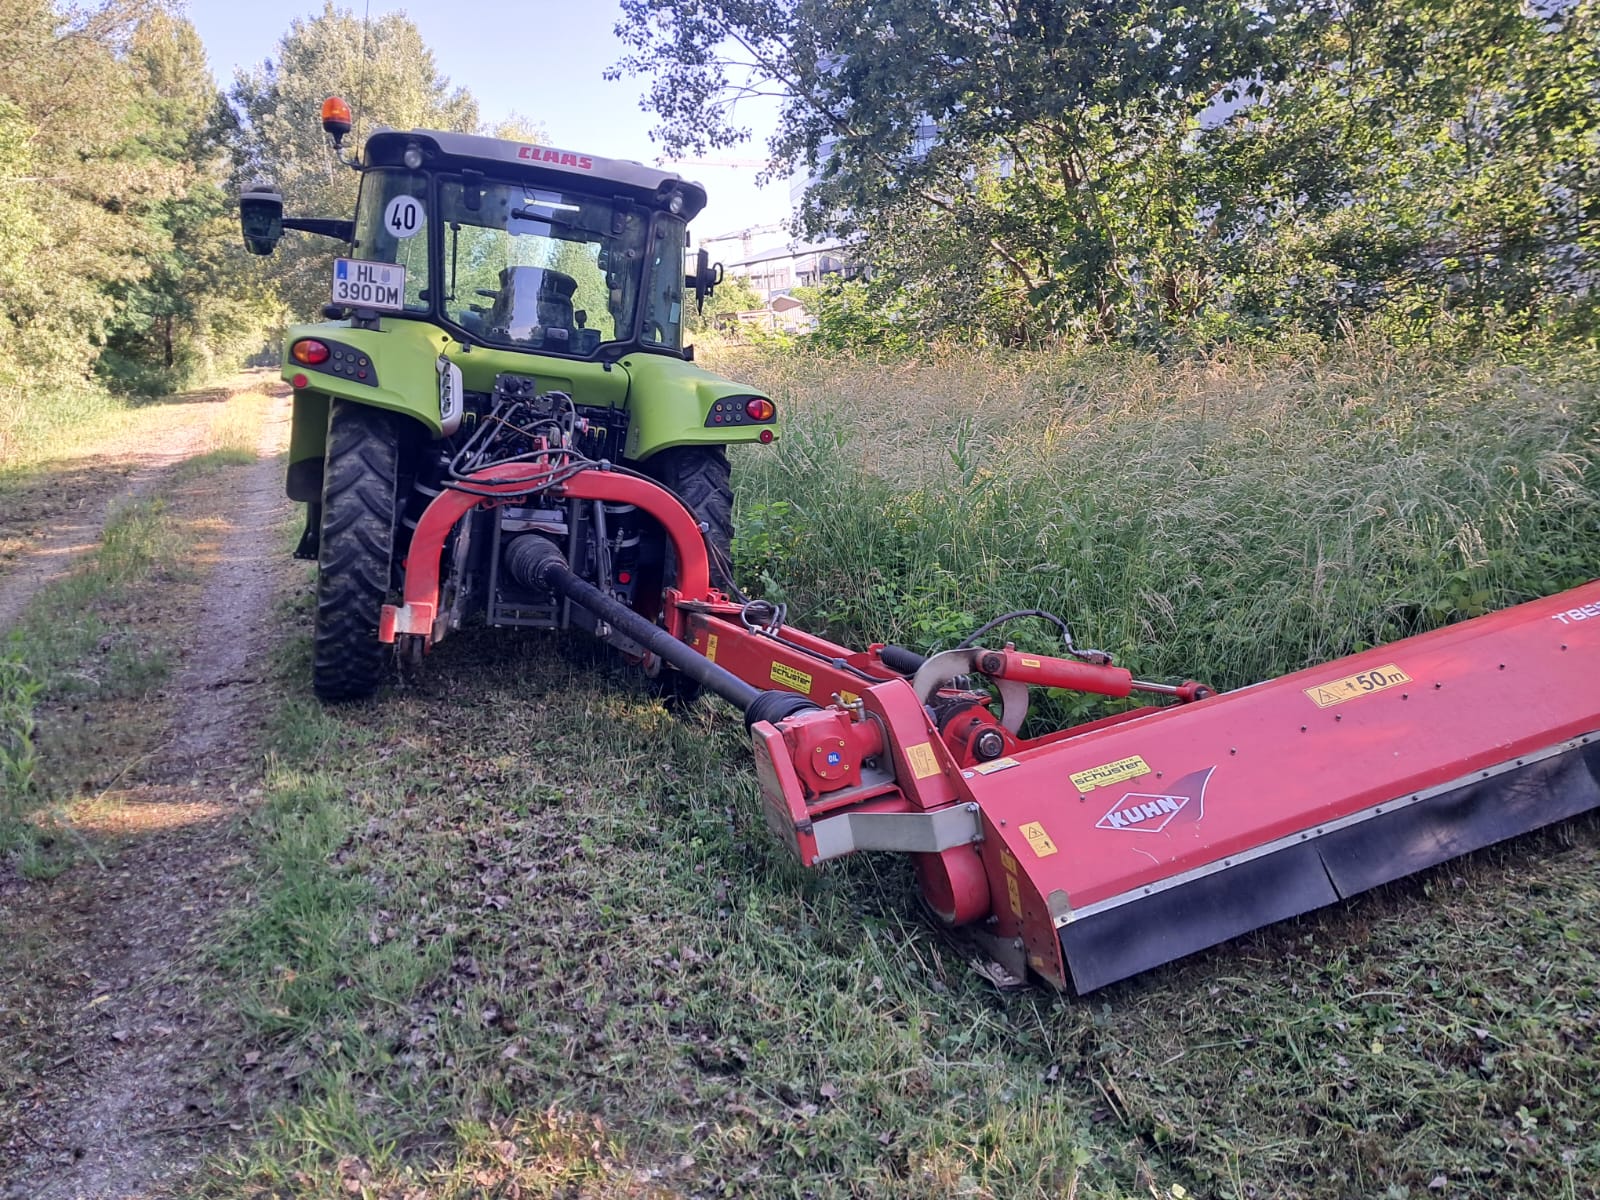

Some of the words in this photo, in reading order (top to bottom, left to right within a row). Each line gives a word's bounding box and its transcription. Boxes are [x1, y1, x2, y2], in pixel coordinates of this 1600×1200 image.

[518, 146, 593, 170] CLAAS
[391, 203, 417, 231] 40
[357, 264, 378, 284] HL
[338, 281, 372, 302] 390
[375, 285, 398, 305] DM
[1356, 671, 1387, 691] 50
[1388, 672, 1405, 683] m
[1106, 796, 1180, 829] KUHN
